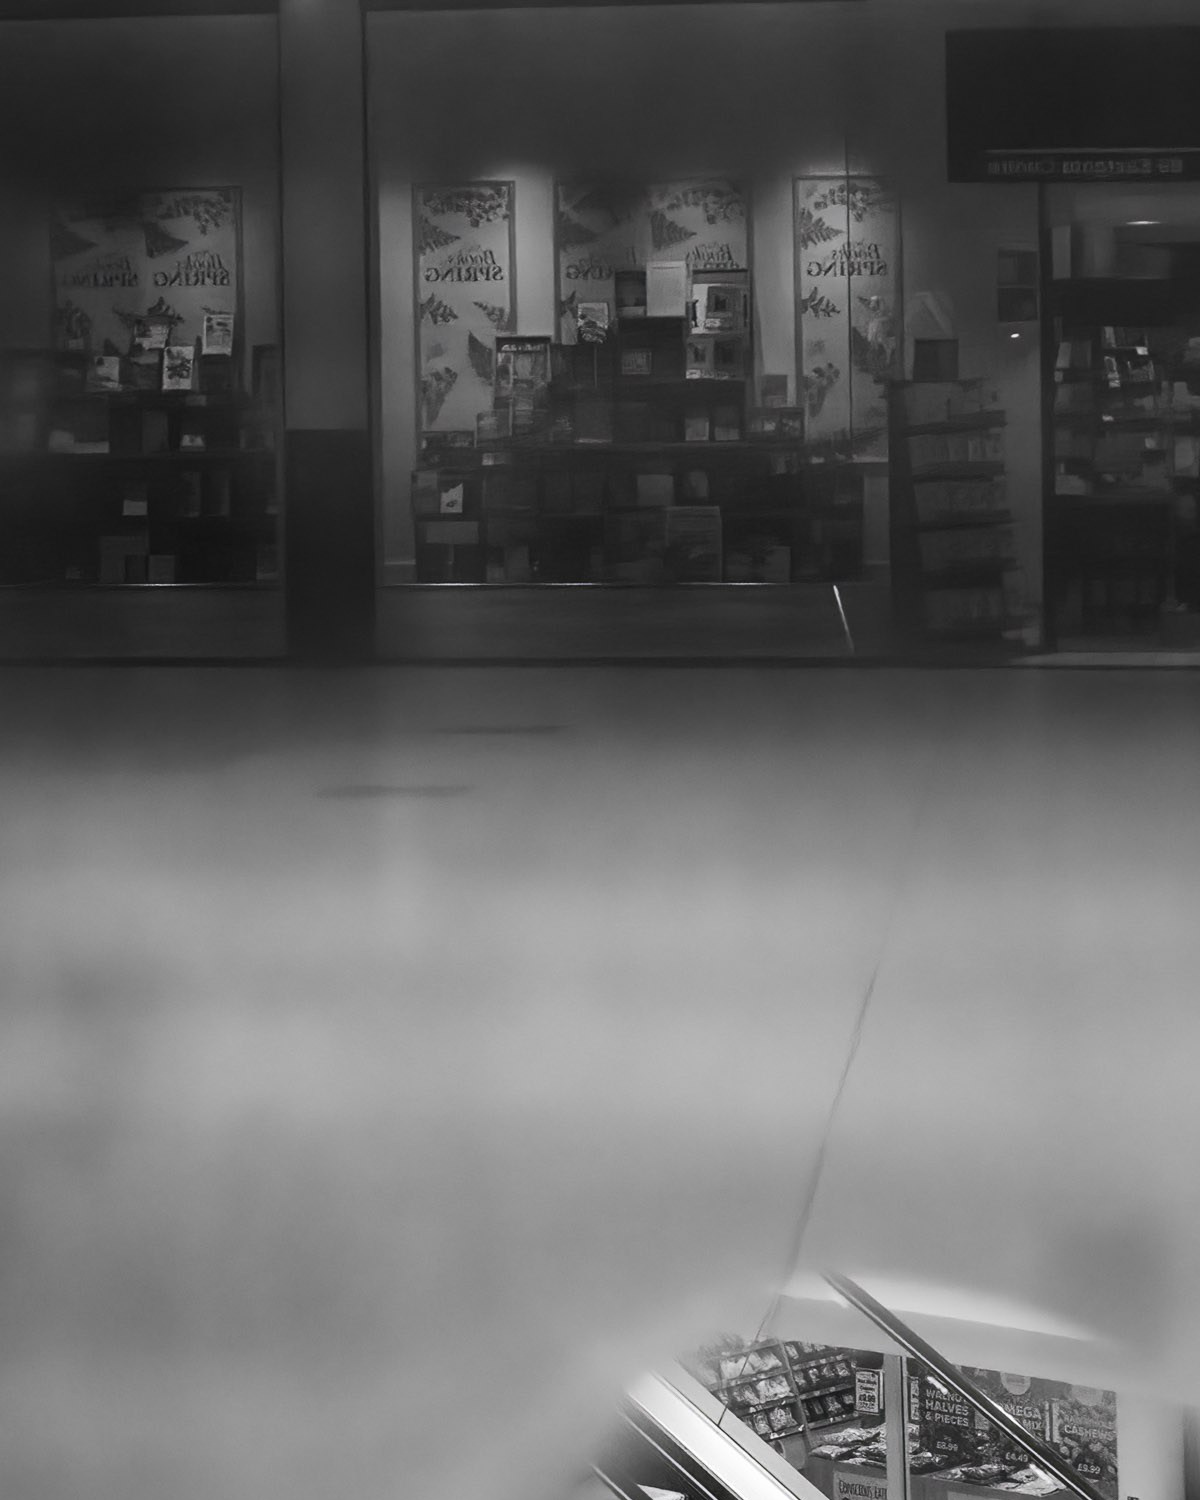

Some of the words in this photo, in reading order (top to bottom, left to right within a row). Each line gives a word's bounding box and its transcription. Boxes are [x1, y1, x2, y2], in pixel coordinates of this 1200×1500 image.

[925, 1388, 967, 1404] WALNU
[925, 1398, 969, 1416] HALVES
[1000, 1402, 1042, 1420] MEGA
[934, 1412, 969, 1427] PIECES
